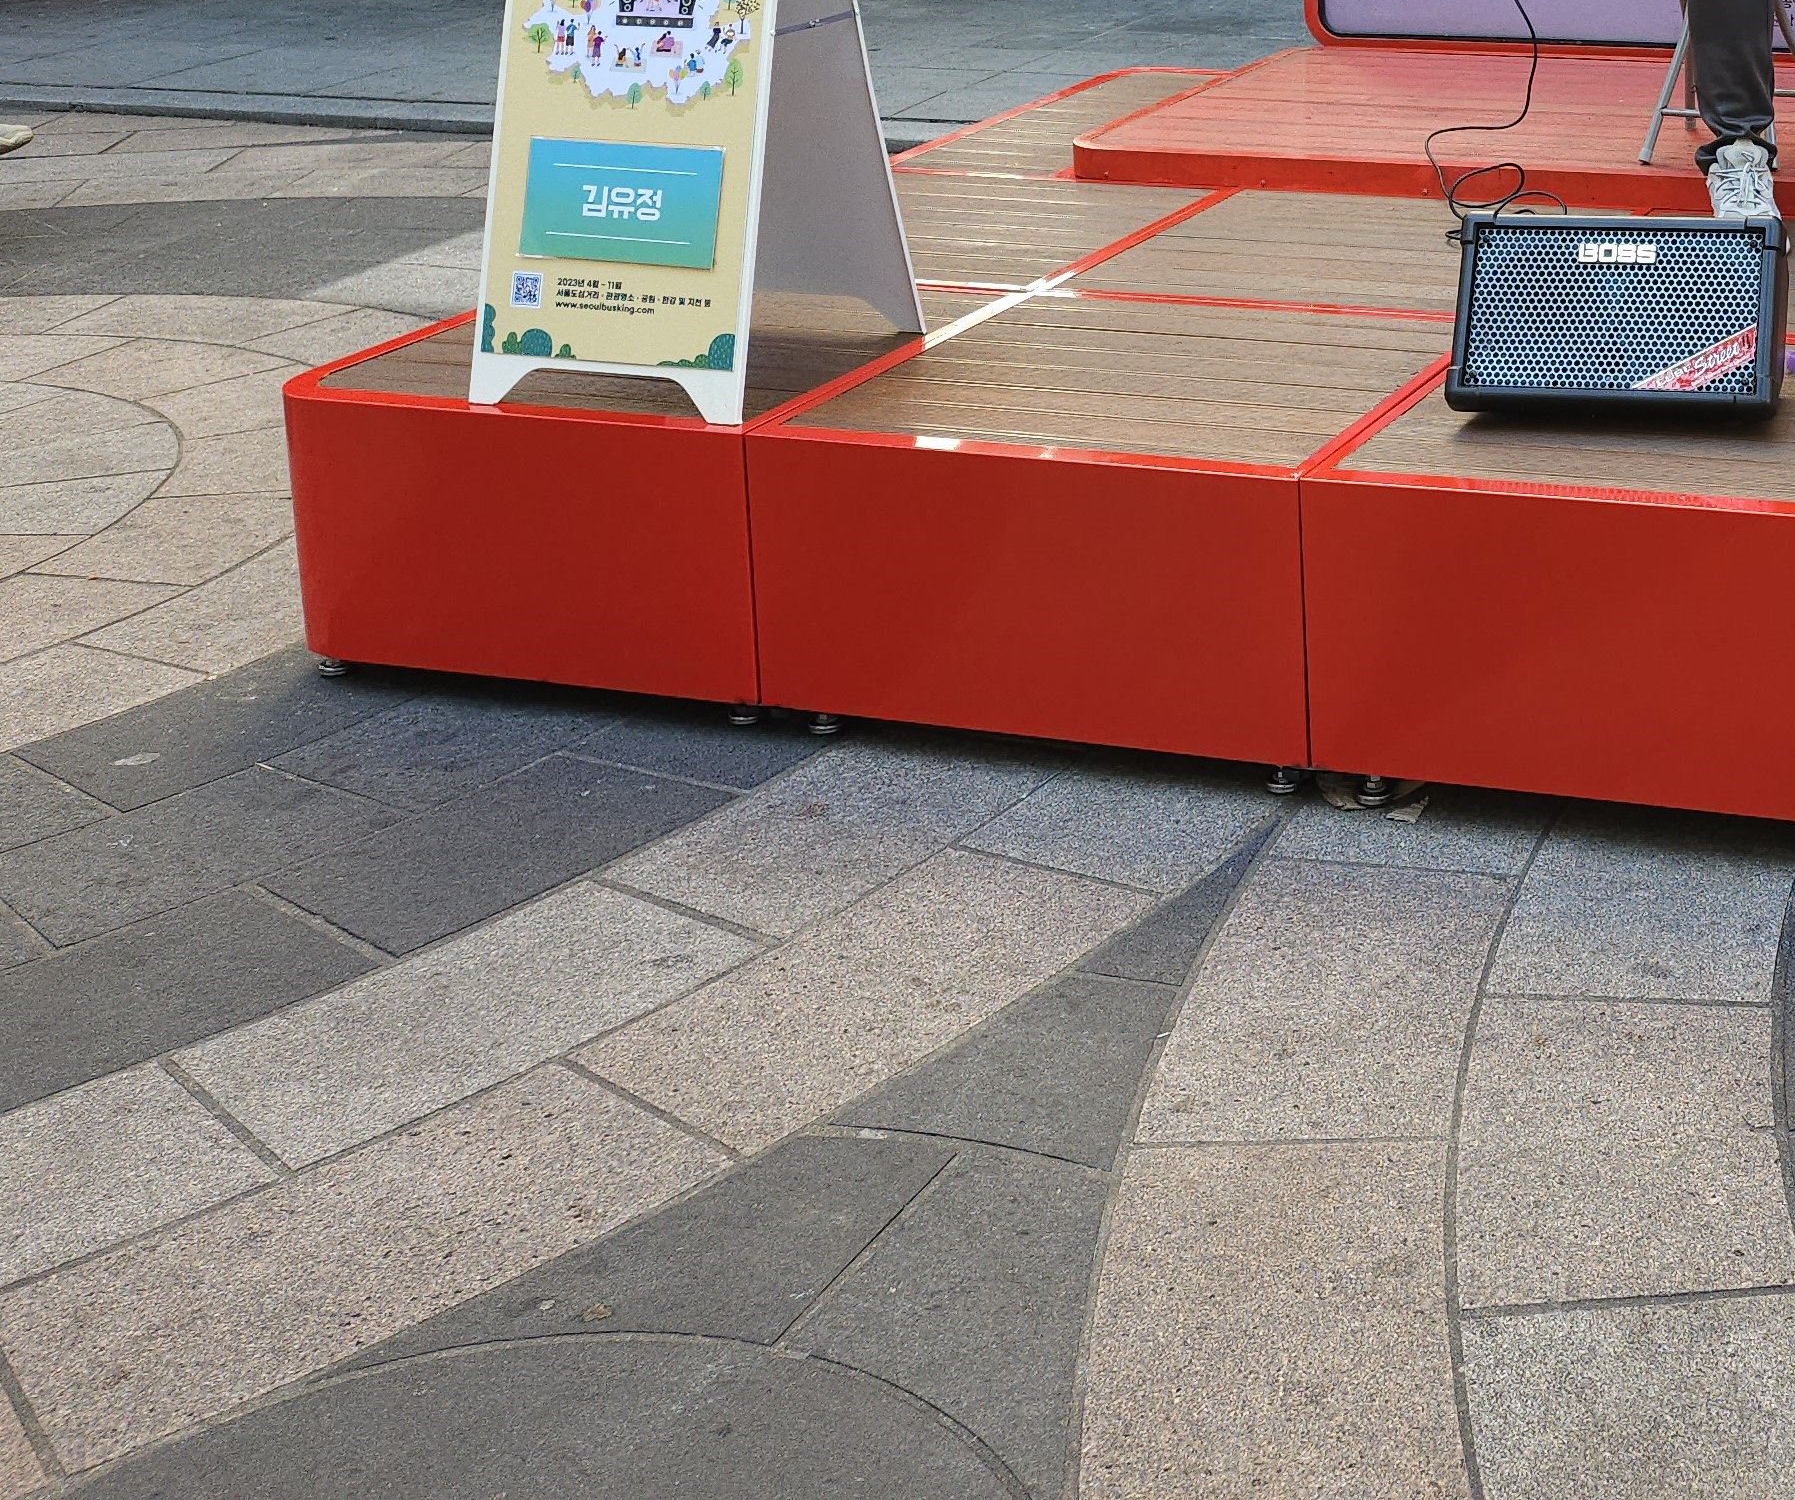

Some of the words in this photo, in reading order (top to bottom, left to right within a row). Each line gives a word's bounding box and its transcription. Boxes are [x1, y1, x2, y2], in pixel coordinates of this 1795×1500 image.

[582, 184, 663, 222] 김유정
[1577, 243, 1658, 264] BOSS
[557, 277, 585, 288] 2023년
[586, 279, 600, 289] 4월
[555, 301, 655, 315] www.seoulbusking.com
[1691, 342, 1741, 378] Street
